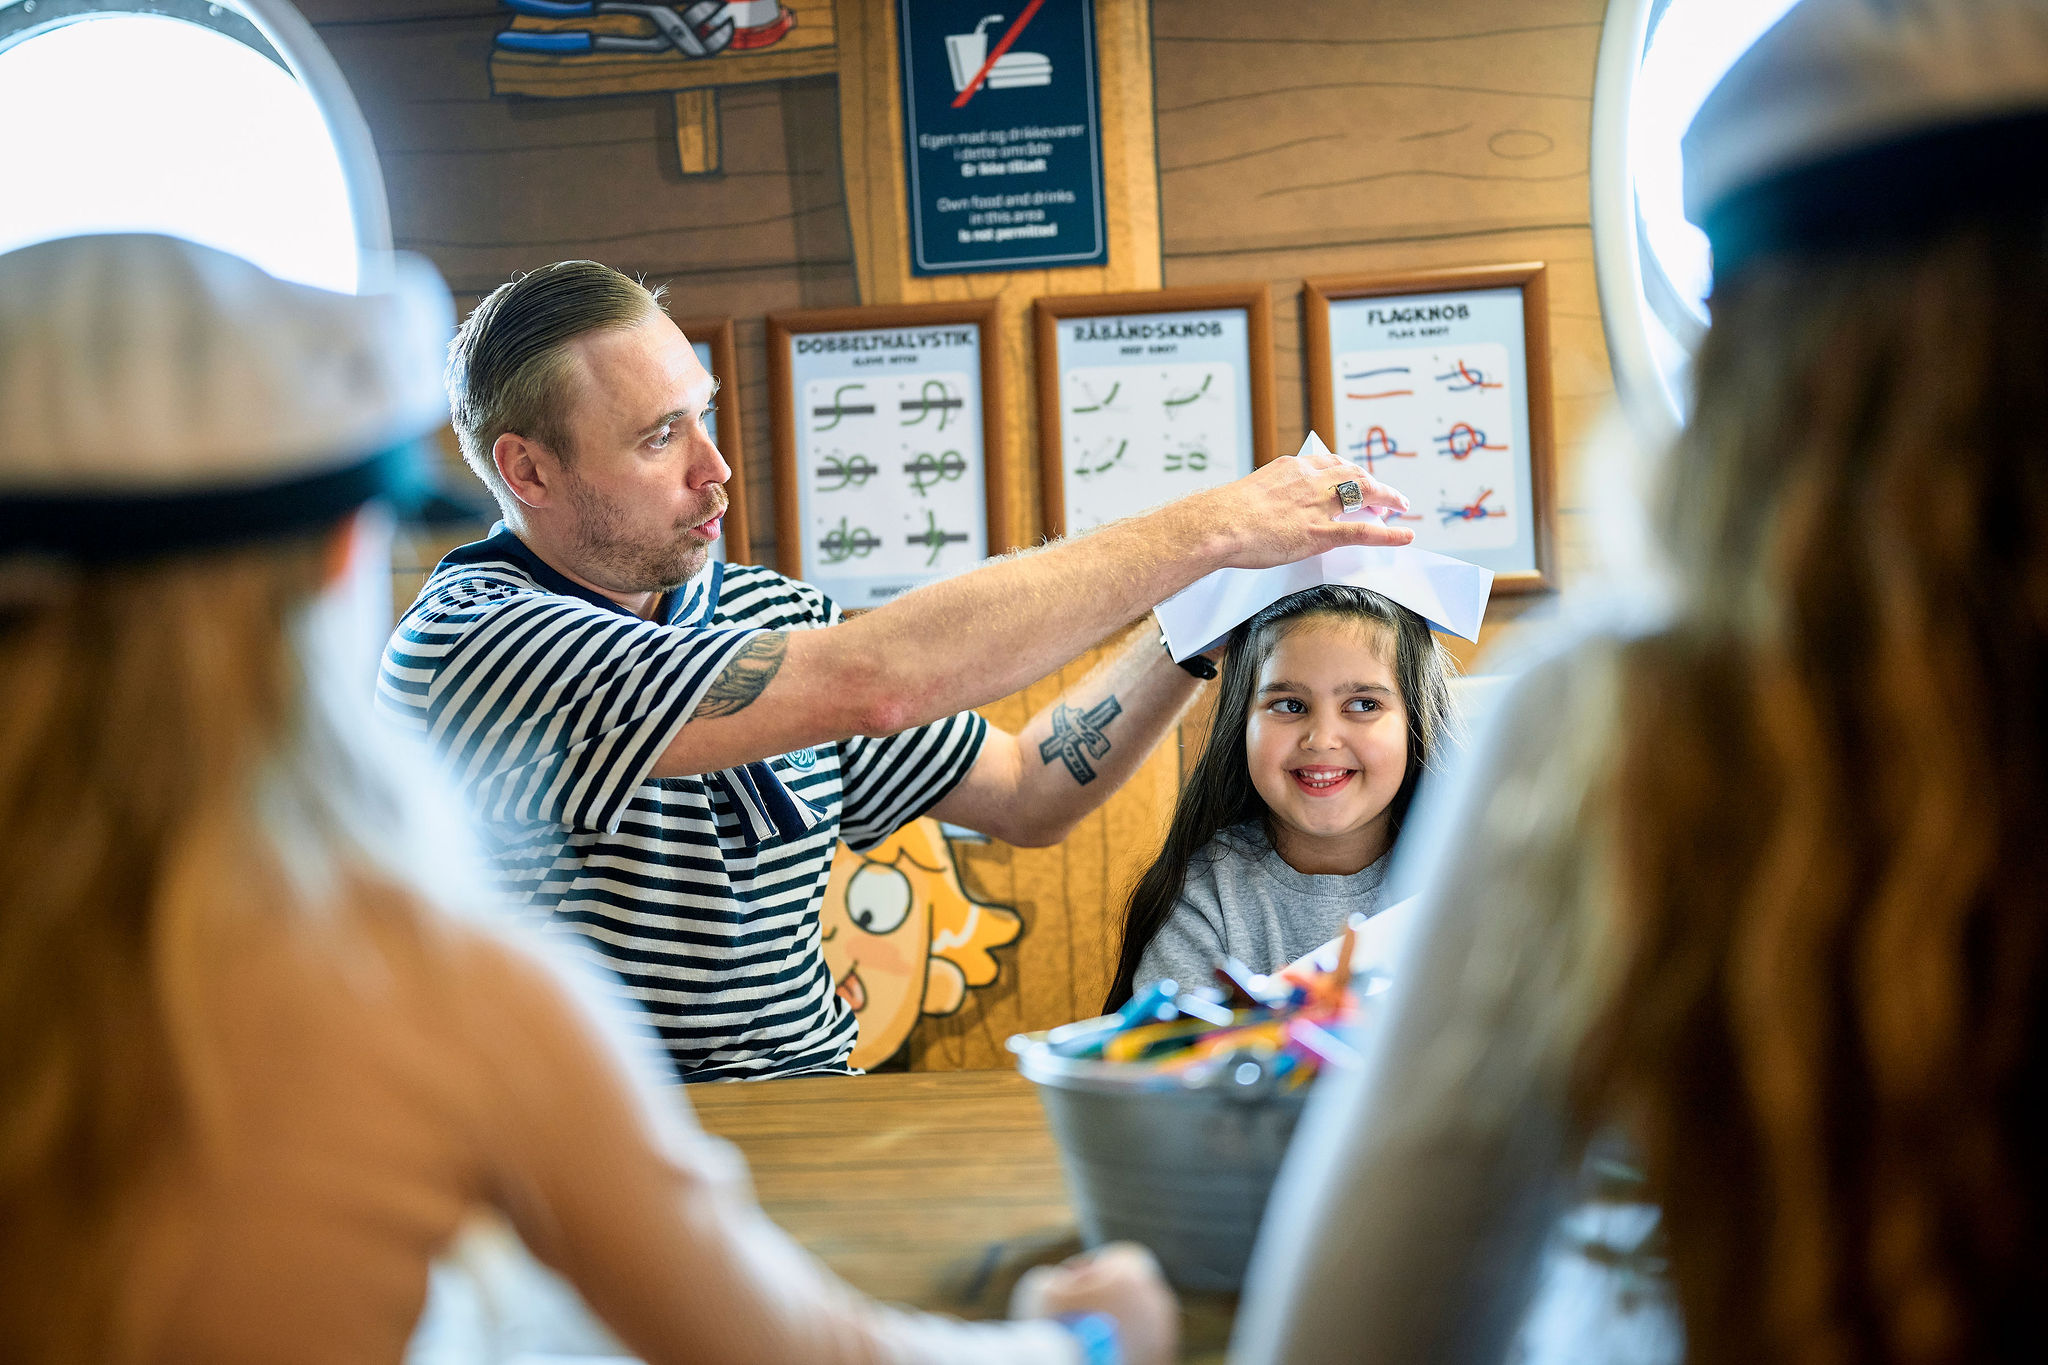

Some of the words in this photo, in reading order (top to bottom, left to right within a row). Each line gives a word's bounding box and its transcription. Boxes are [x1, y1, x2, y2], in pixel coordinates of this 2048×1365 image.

[937, 197, 968, 212] Own
[971, 194, 1004, 209] food
[1005, 192, 1031, 208] and
[1367, 303, 1470, 326] FLAGKNOB
[1074, 320, 1223, 341] RÅBÅNDSKNOB
[797, 330, 973, 354] DOBBELTHALVSTIK
